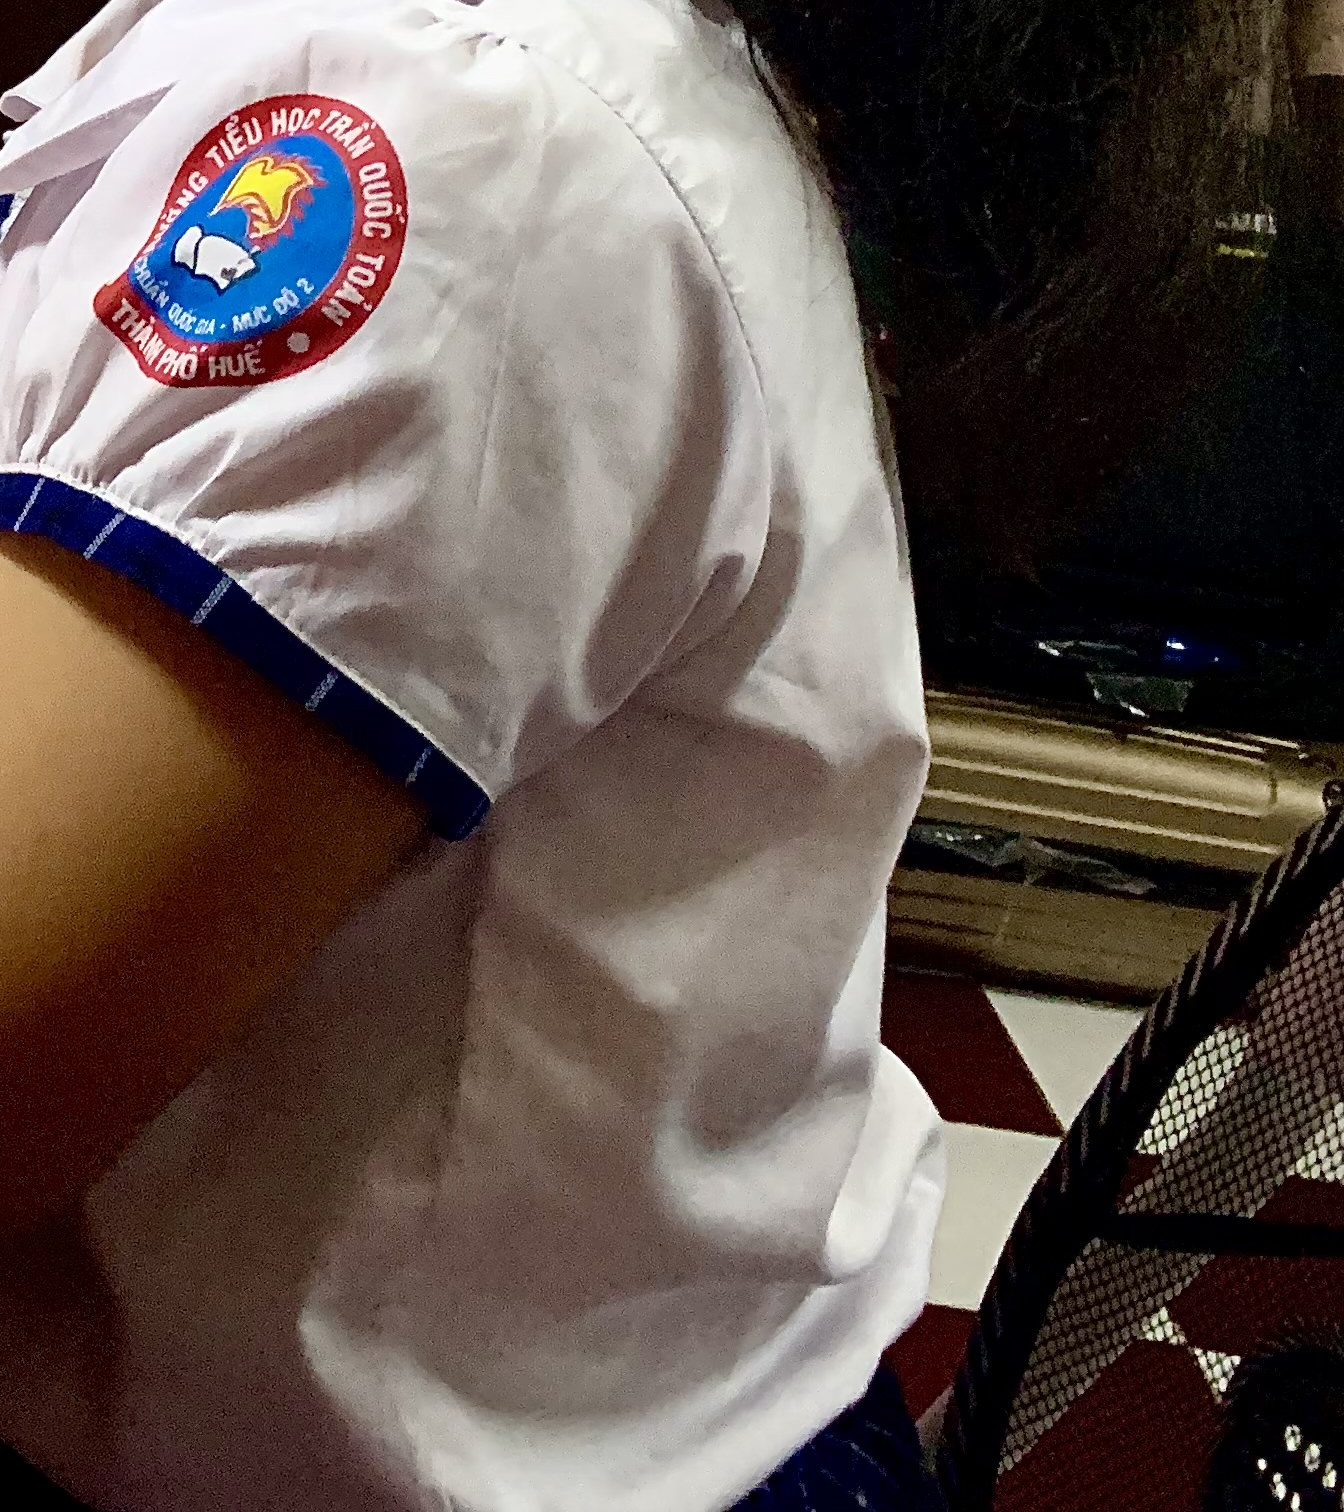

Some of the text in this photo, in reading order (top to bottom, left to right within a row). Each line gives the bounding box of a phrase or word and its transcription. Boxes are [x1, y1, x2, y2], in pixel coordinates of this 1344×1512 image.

[205, 113, 263, 169] TIỂU
[270, 107, 321, 138] HỌC
[317, 109, 378, 160] TRẦN
[358, 161, 406, 240] QUỐC
[296, 277, 315, 296] 2
[155, 345, 209, 381] PHỐ
[208, 339, 266, 380] HUẾ
